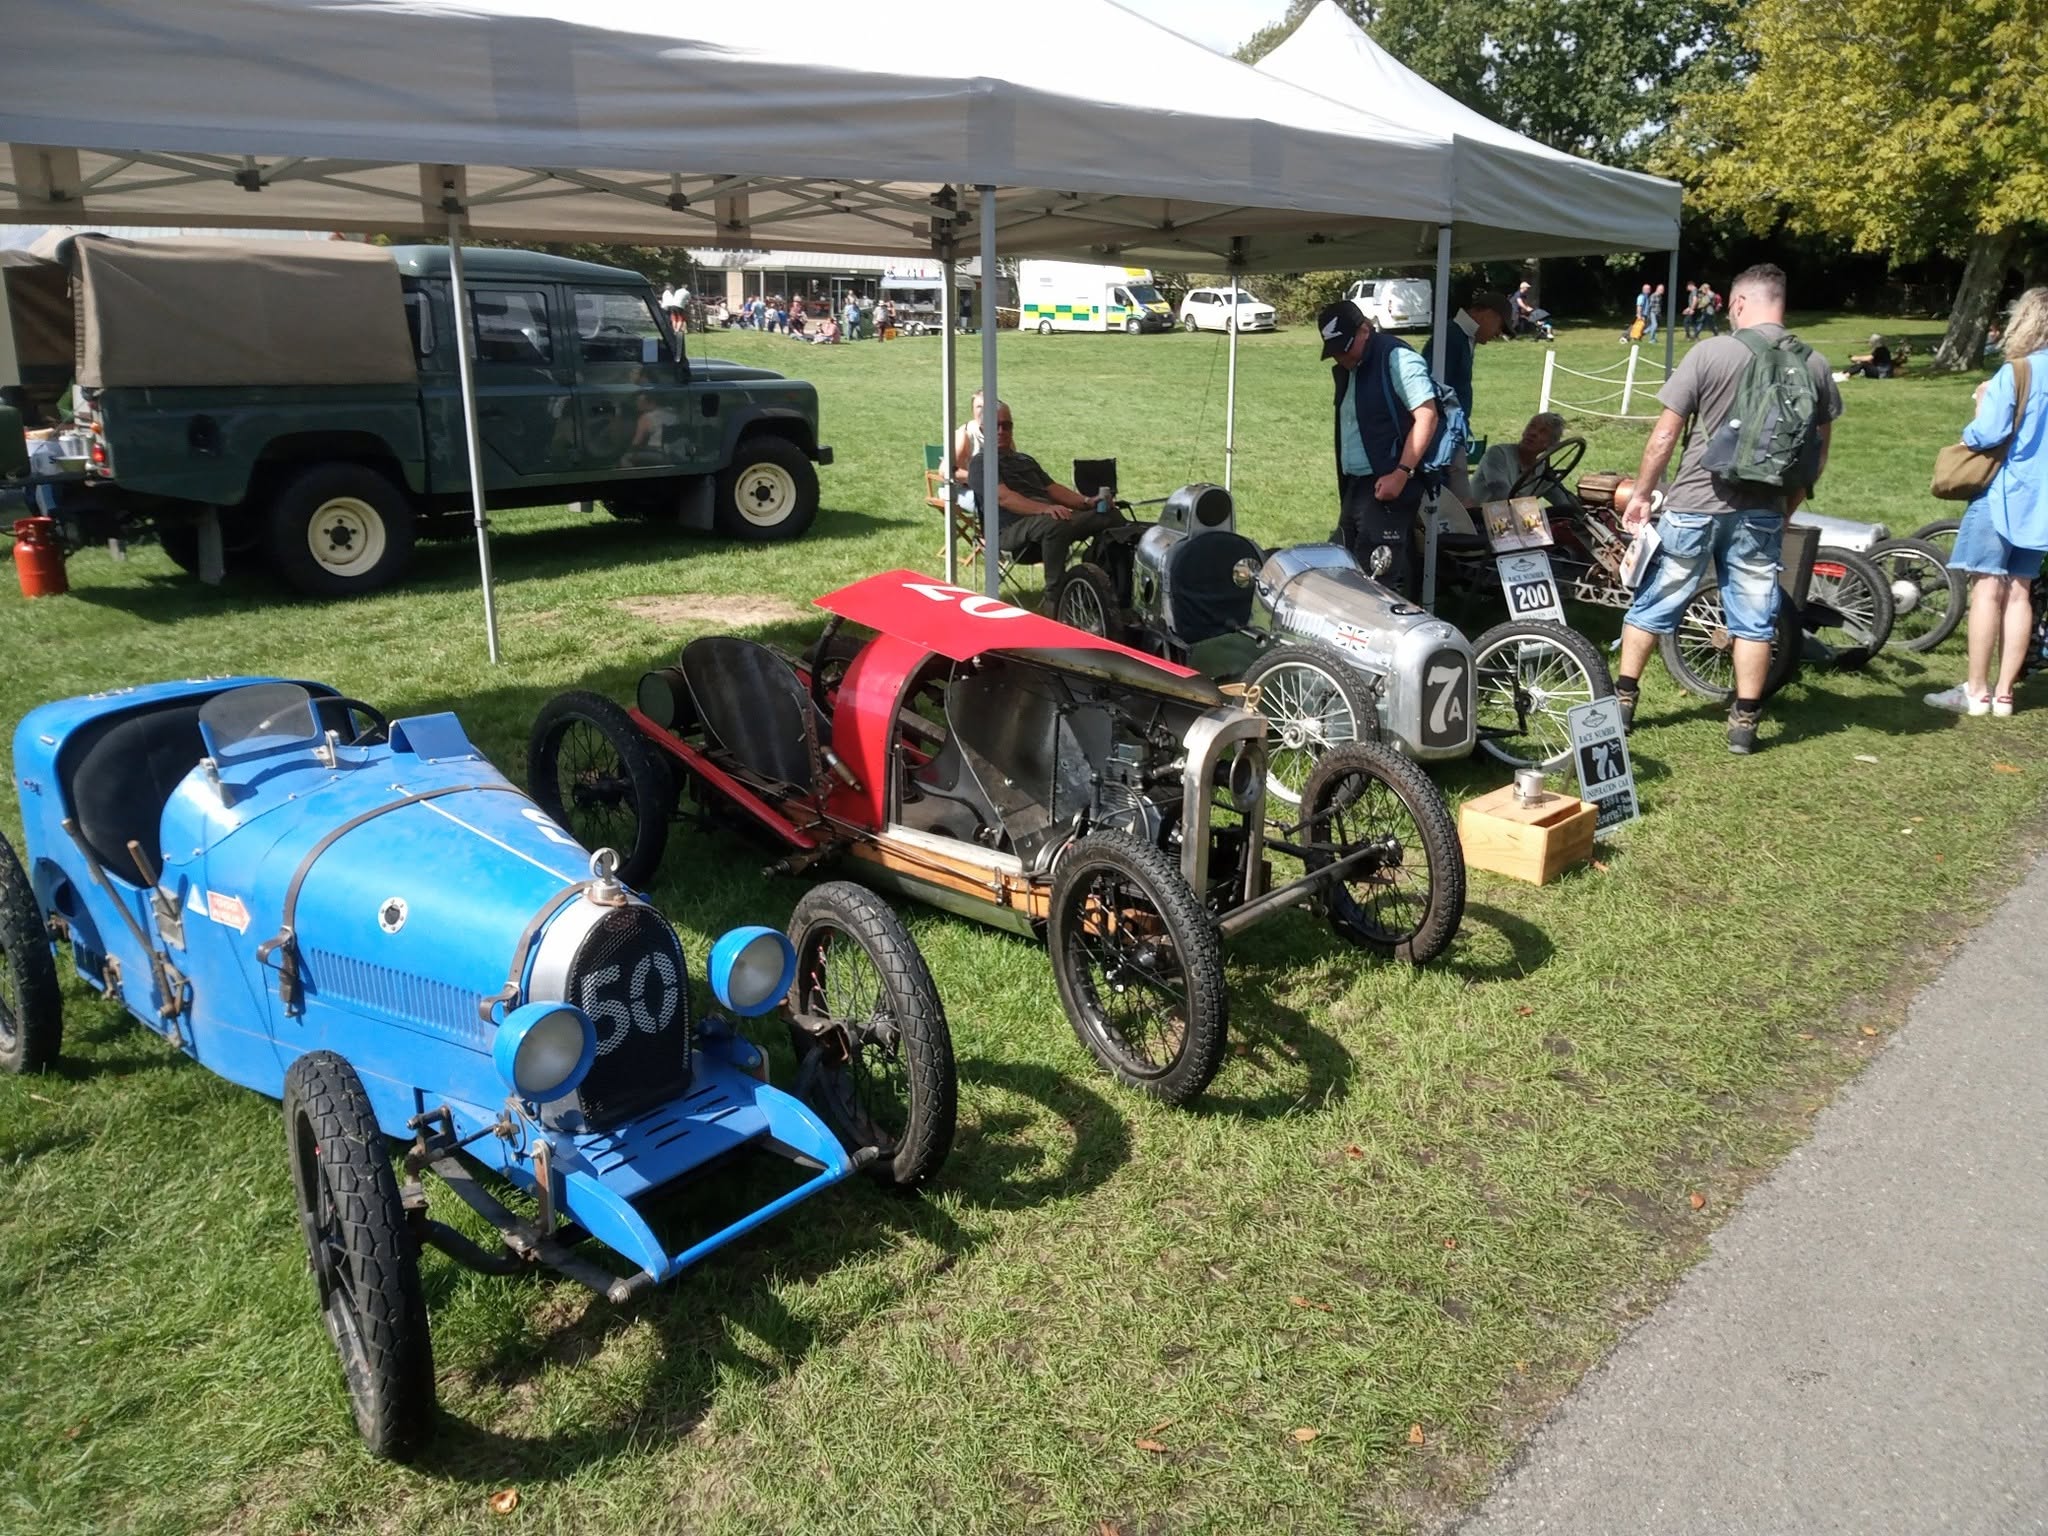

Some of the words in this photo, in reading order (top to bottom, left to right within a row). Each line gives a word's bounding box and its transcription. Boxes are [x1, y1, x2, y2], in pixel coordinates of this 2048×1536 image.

[1523, 571, 1545, 579] NUMBER
[1515, 583, 1550, 610] 200
[1427, 665, 1464, 734] 7A
[1578, 732, 1593, 743] RACE
[1594, 726, 1617, 738] NUMBER
[1591, 744, 1620, 780] 7A
[1586, 781, 1617, 799] INSPIRATION
[1617, 777, 1630, 788] CAR
[580, 951, 678, 1056] 50
